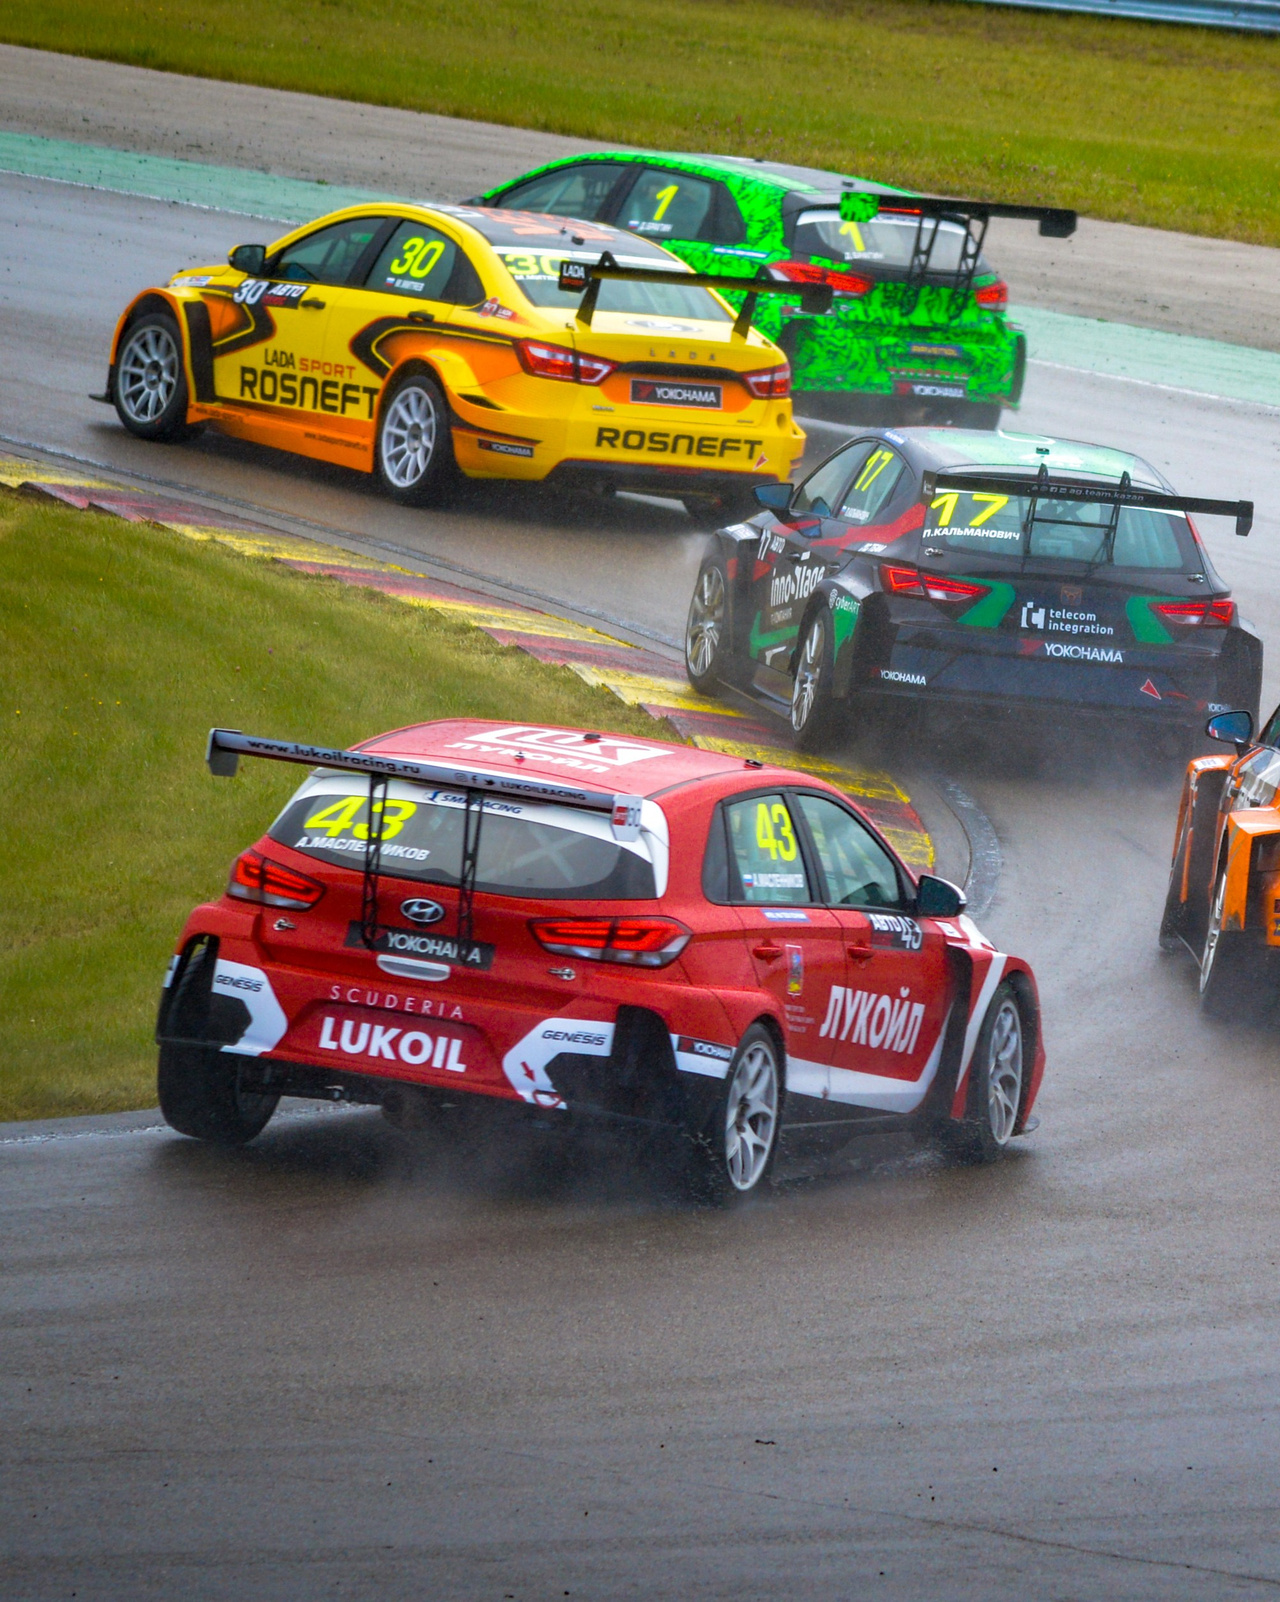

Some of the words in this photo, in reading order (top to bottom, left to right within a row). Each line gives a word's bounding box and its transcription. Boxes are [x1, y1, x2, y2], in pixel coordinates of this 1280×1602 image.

[656, 185, 679, 221] 1
[839, 221, 866, 252] 1
[390, 237, 446, 278] 30
[562, 264, 585, 279] LADA
[233, 279, 270, 305] 30
[268, 284, 308, 298] АВТО
[264, 348, 296, 370] LADA
[299, 357, 356, 379] SPORT
[650, 348, 716, 361] LADA
[240, 366, 381, 420] ROSNEFT
[655, 387, 717, 403] YOKOHAMA
[596, 427, 763, 460] ROSNEFT
[855, 450, 894, 492] 17
[930, 492, 1009, 527] 17
[1069, 488, 1144, 501] ag.team.kazan
[757, 529, 772, 561] 17
[923, 527, 1020, 541] П.КАЛЬМАНОВИЧ
[1048, 620, 1114, 635] integration
[1050, 609, 1097, 621] telecom
[1045, 643, 1123, 663] YOKOHAMA
[880, 669, 927, 686] YOKOHAMA
[247, 740, 421, 774] www.lukoilracing.ru
[444, 742, 612, 773] ЛУКОЙЛ
[500, 780, 587, 801] LUKOILRACING
[304, 795, 418, 841] 43
[756, 803, 797, 862] 43
[295, 836, 430, 861] А.МАСЛЕИКОВ
[868, 914, 901, 932] АВТО
[895, 916, 923, 949] 43
[387, 932, 481, 963] YOKOHAA
[215, 974, 263, 992] GENESIS
[330, 985, 463, 1020] SCUDERIA
[819, 985, 926, 1055] ЛУКОЙЛ
[318, 1017, 467, 1073] LUKOIL
[542, 1030, 606, 1046] GENESIS
